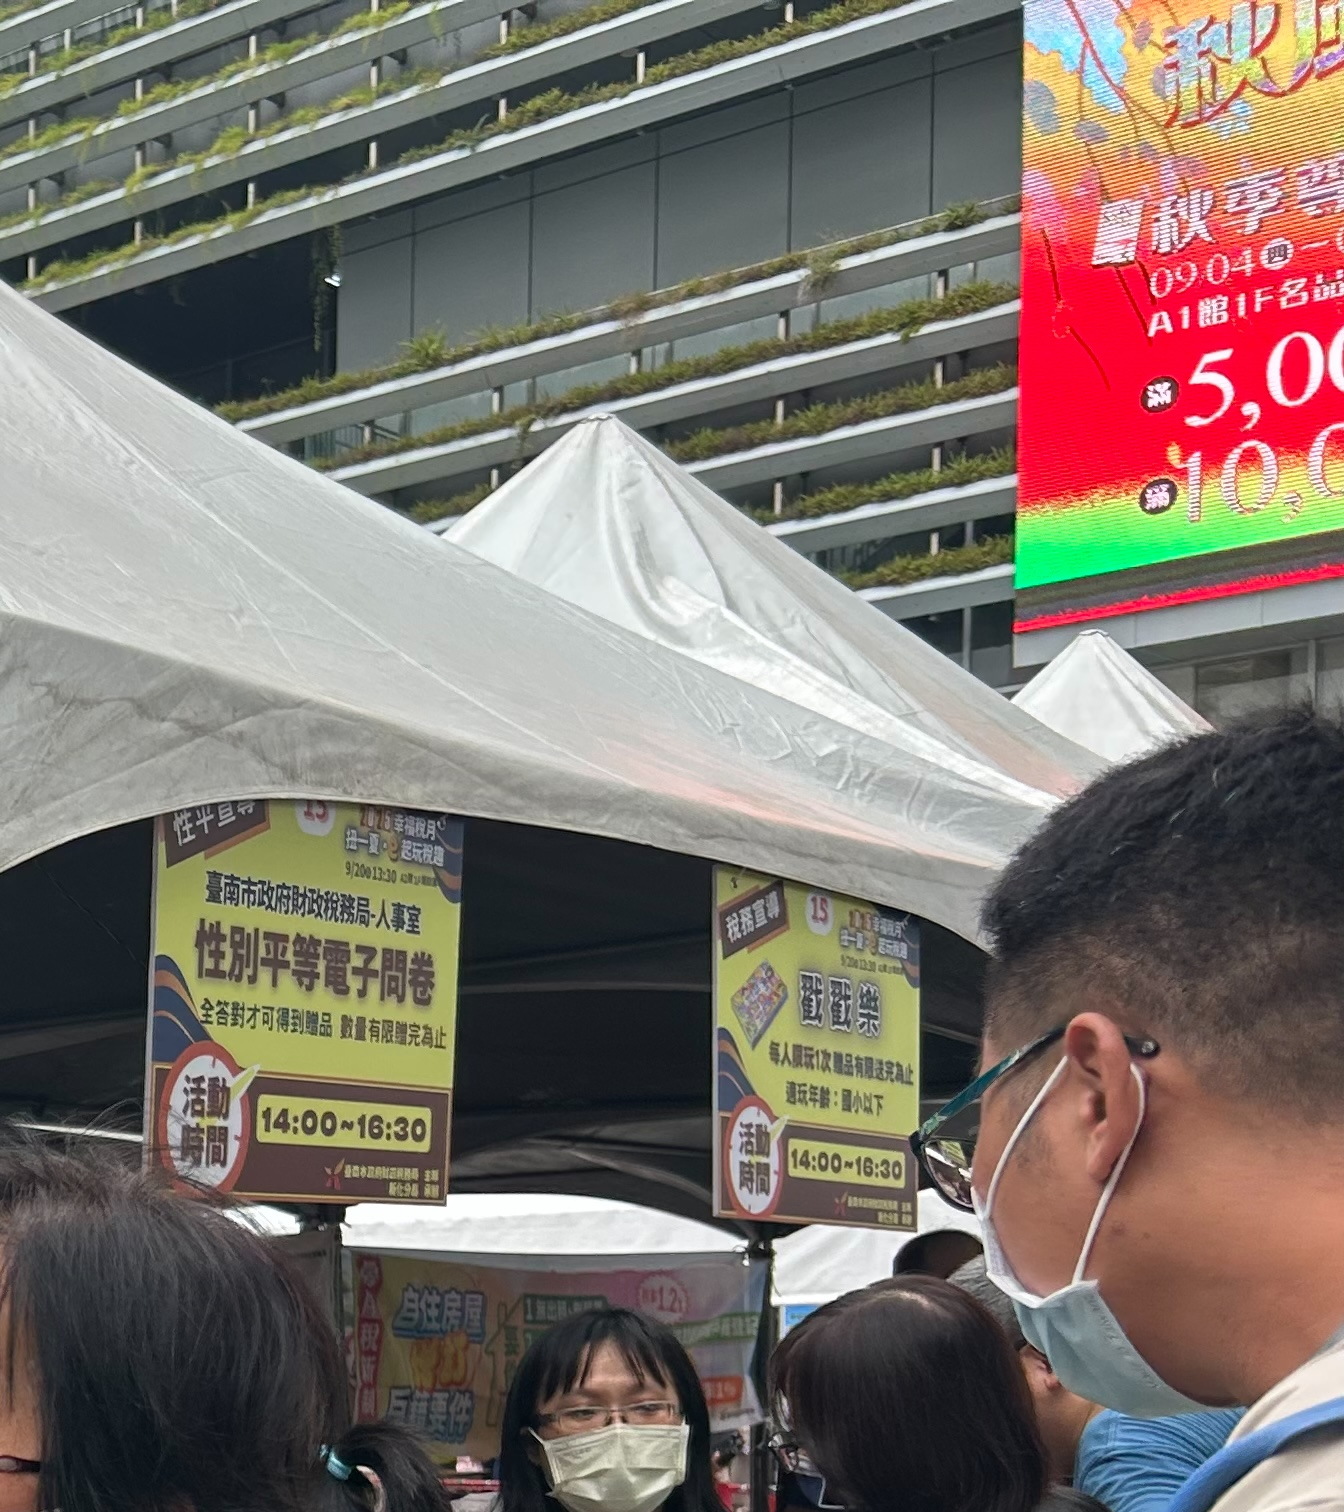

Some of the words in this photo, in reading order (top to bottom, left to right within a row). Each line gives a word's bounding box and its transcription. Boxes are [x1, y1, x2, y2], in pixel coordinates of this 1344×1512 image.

[1184, 325, 1344, 432] 5,0
[194, 917, 436, 1006] 性別平等電子問卷
[199, 997, 333, 1039] 全答對才可得到贈品
[182, 1074, 231, 1122] 活動
[261, 1106, 428, 1143] 14:00~16:30
[739, 1121, 771, 1158] 活動
[180, 1124, 230, 1169] 時間
[790, 1148, 903, 1181] 14:00~16:30
[739, 1160, 771, 1197] 時間
